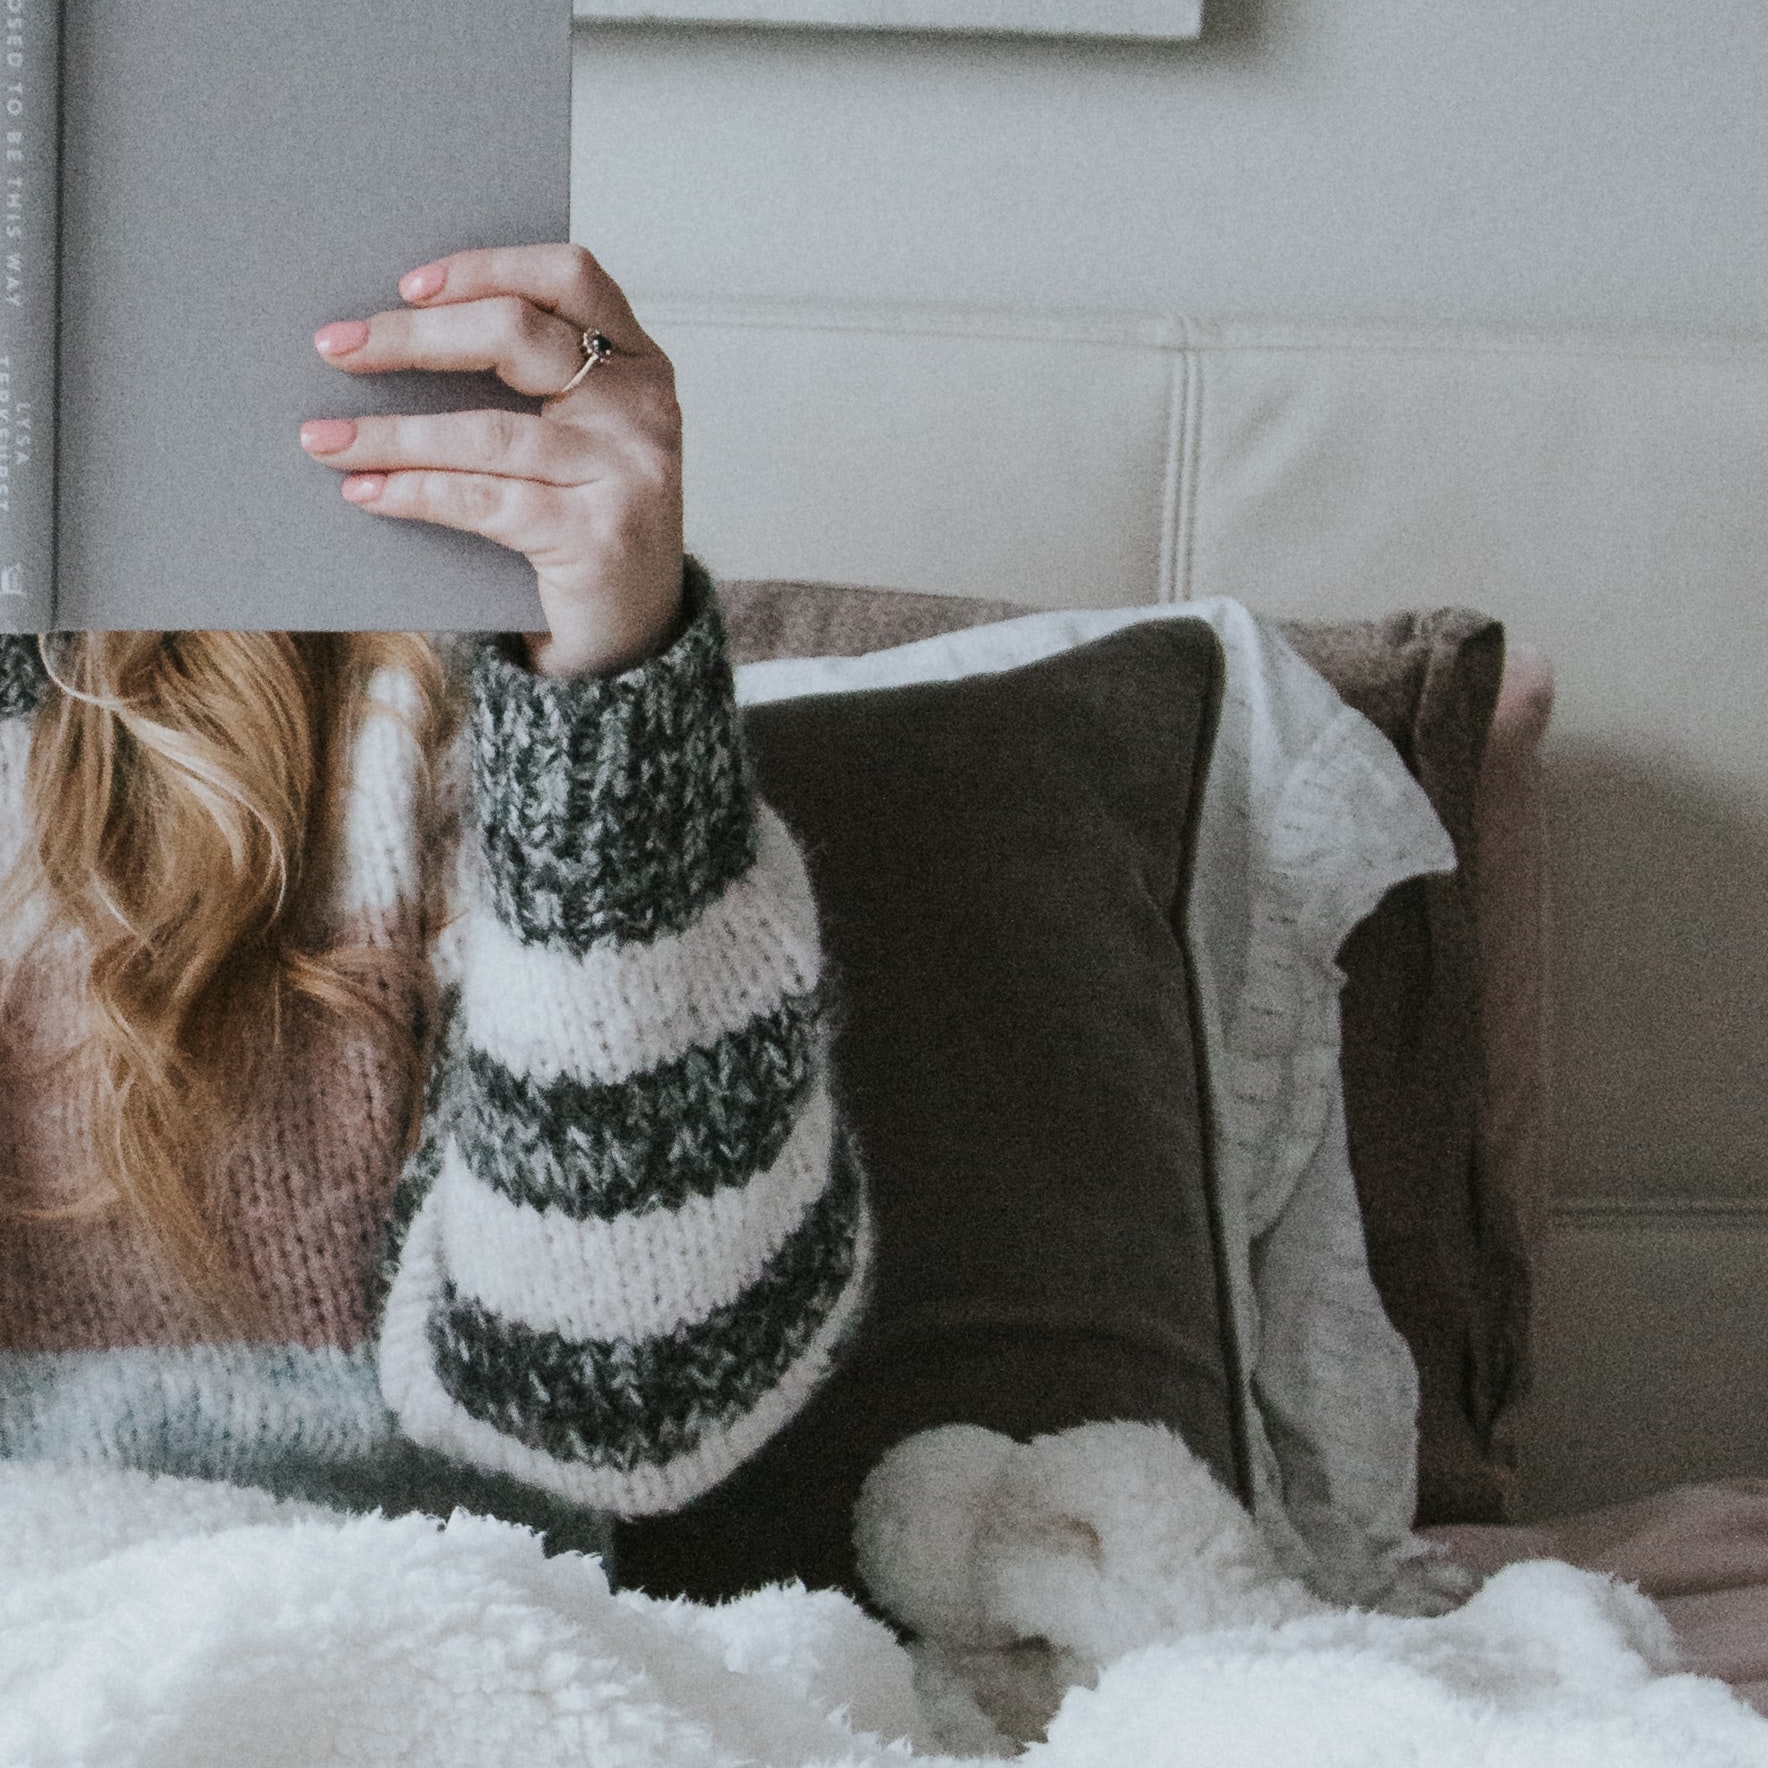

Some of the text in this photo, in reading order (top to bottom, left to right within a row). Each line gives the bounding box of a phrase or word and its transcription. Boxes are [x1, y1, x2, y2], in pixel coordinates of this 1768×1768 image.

[6, 81, 24, 116] TO
[6, 130, 24, 162] BE
[6, 177, 24, 238] THIS
[5, 253, 23, 307] WAY
[15, 402, 32, 465] LYSA
